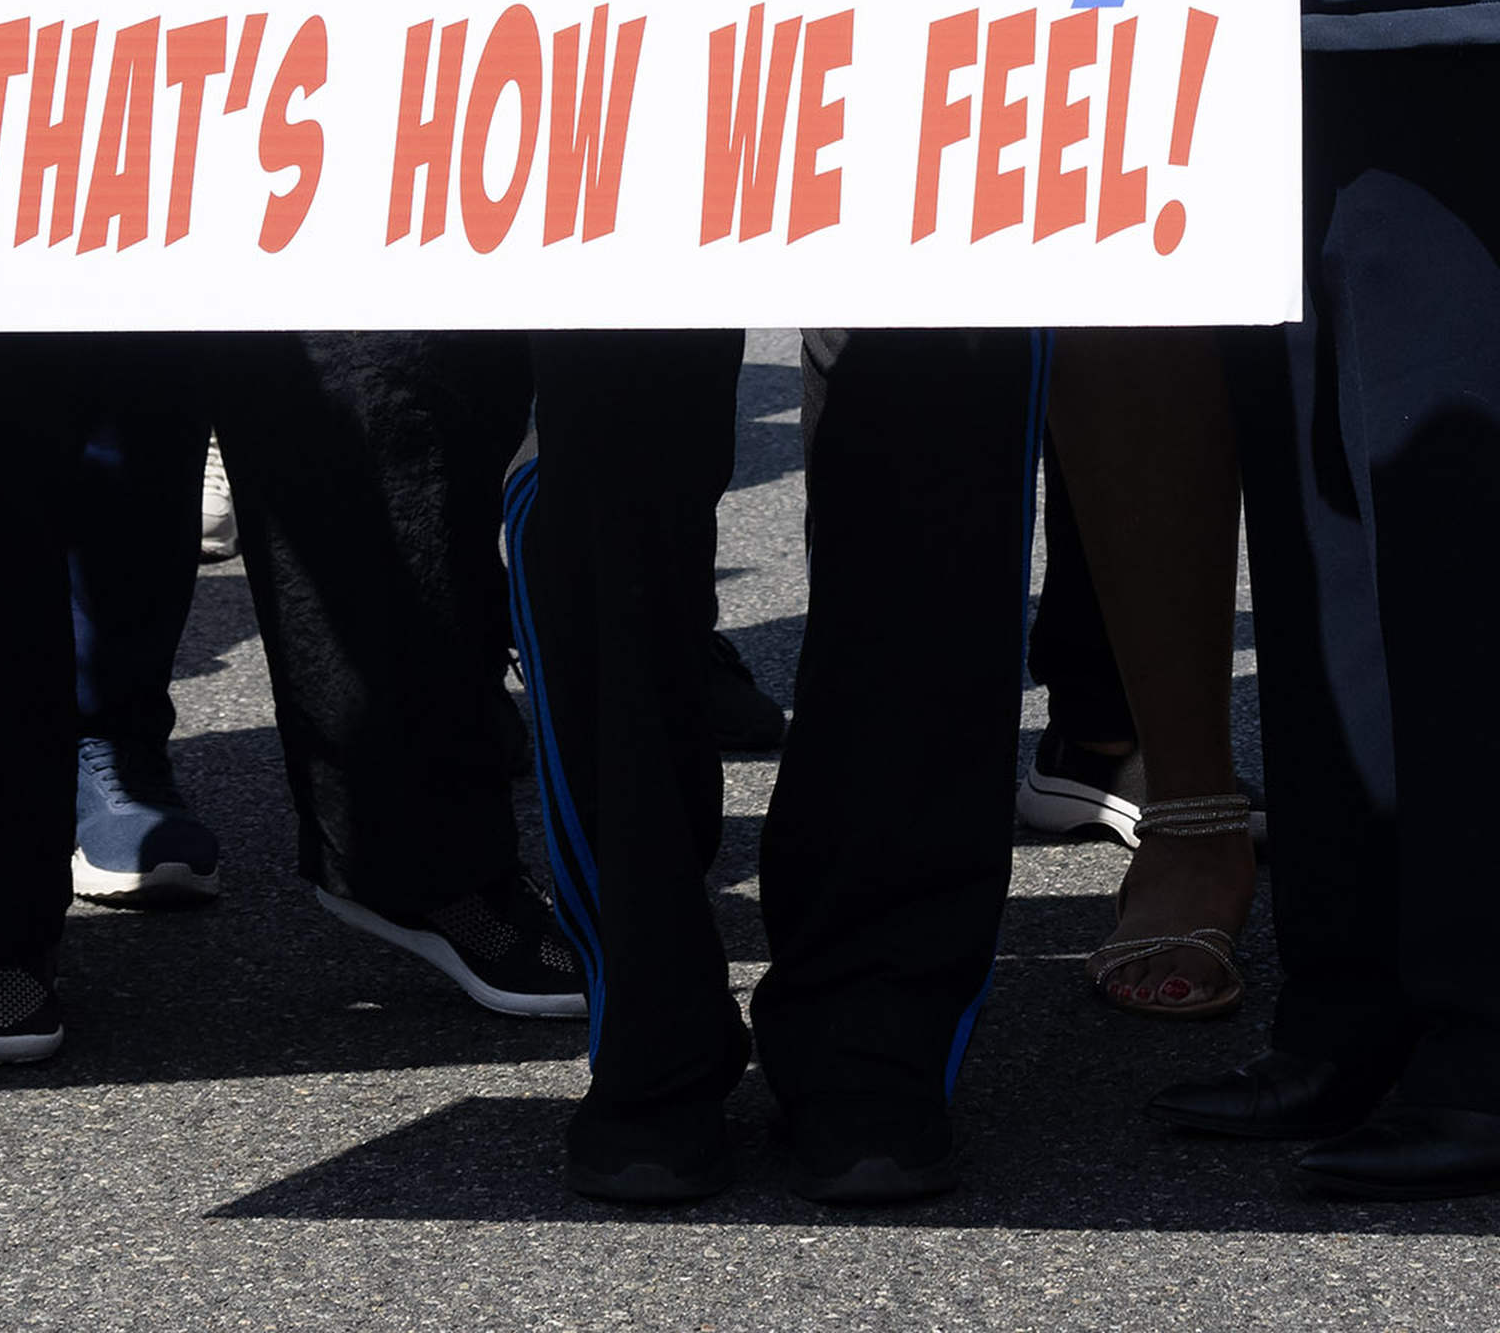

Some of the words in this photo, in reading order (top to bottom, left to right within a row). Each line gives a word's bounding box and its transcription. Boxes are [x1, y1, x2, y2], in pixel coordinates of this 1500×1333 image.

[386, 3, 646, 254] HOW
[700, 3, 854, 246] WE
[911, 8, 1218, 256] FEEL!
